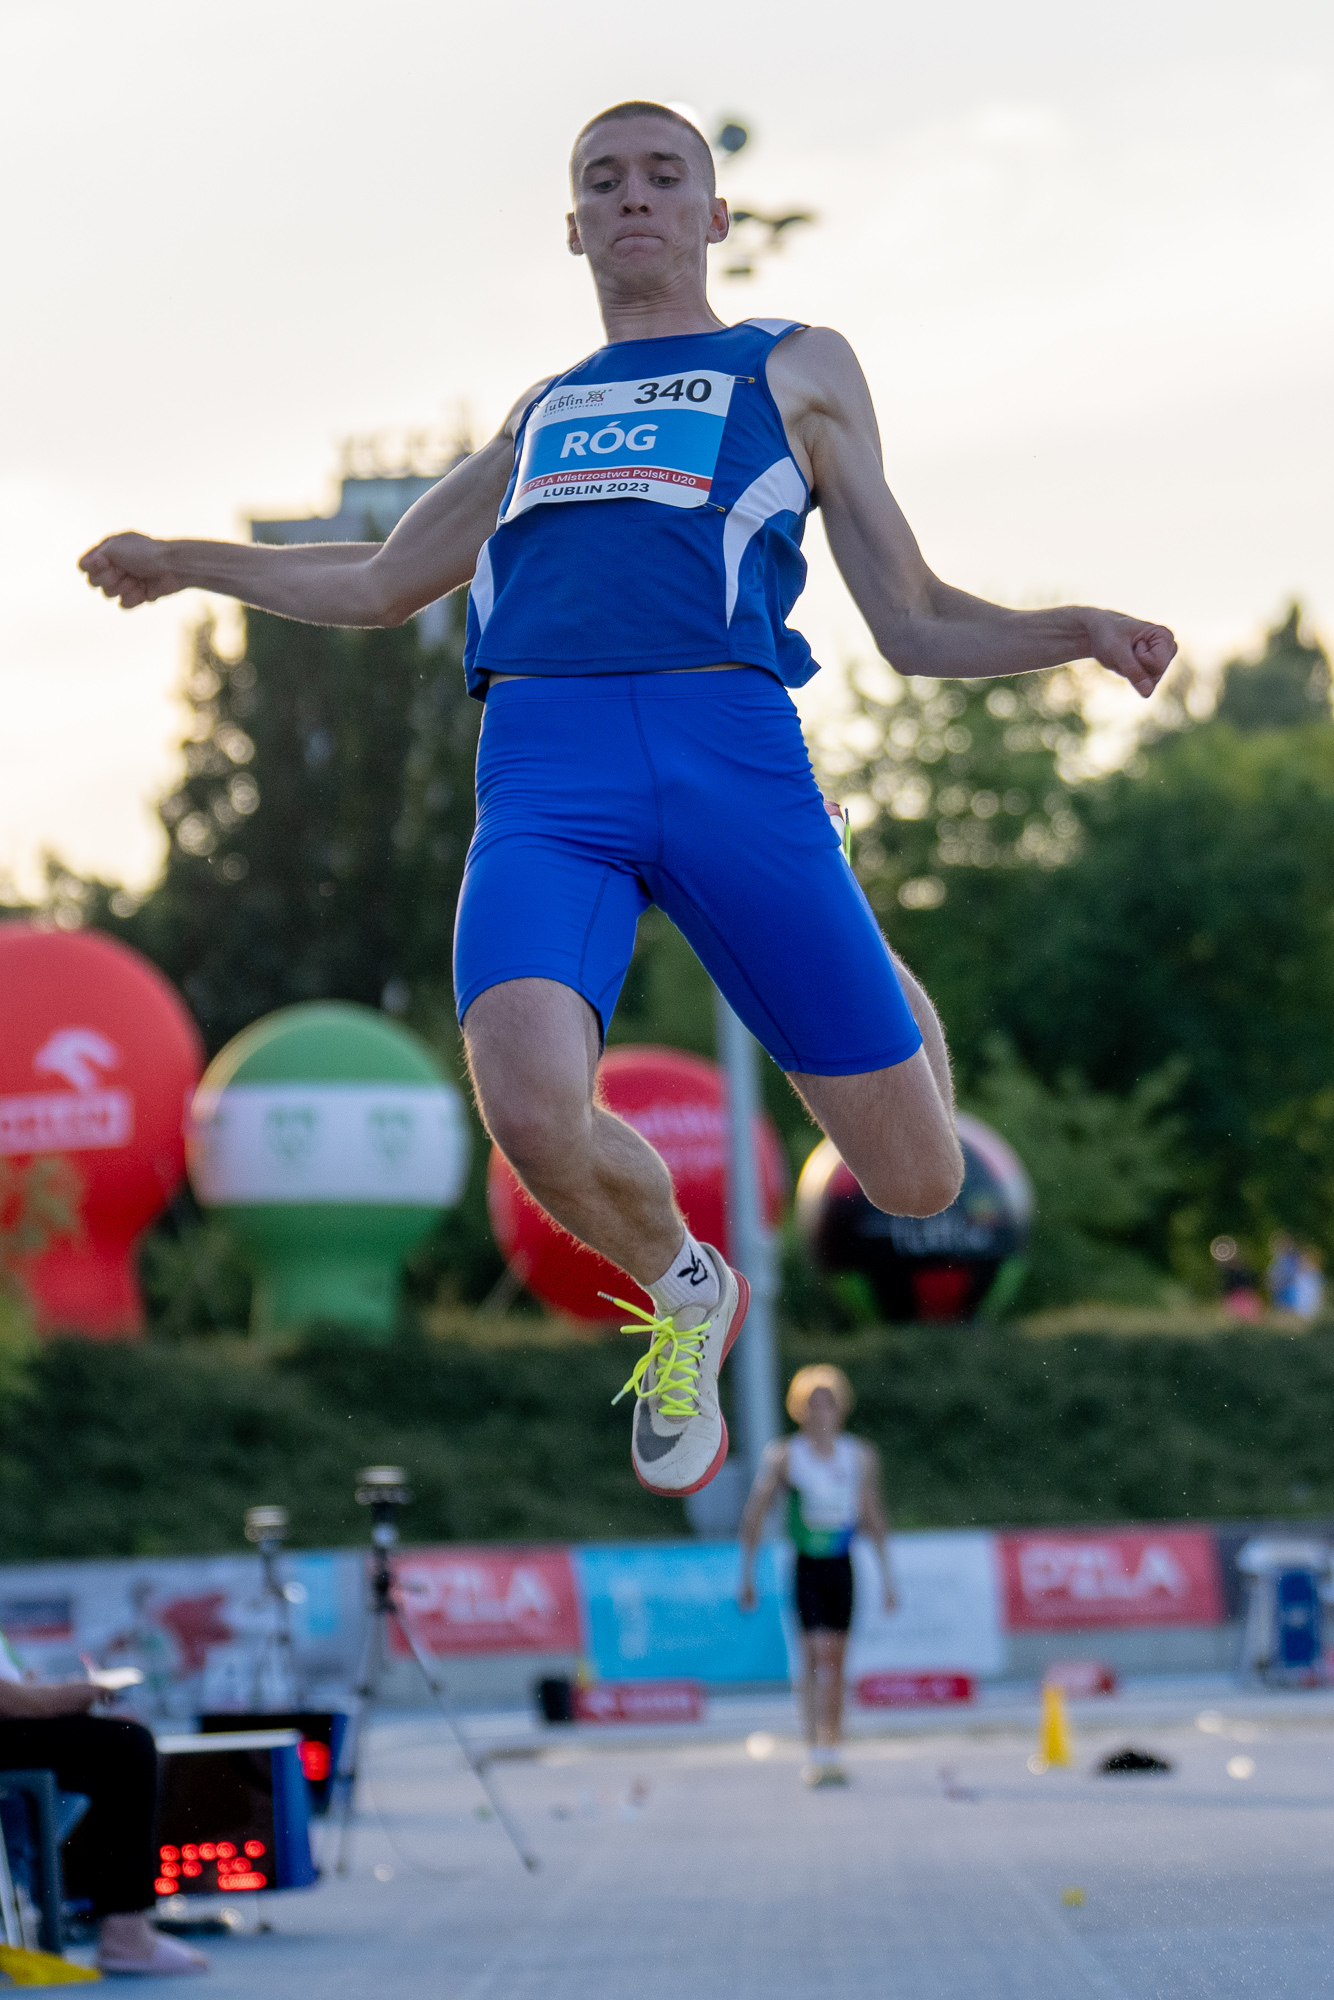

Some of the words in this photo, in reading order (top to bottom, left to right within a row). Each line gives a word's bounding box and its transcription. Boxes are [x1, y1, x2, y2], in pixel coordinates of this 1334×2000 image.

[634, 378, 712, 404] 340
[560, 421, 659, 459] RÓG
[528, 477, 553, 490] PZLA
[556, 470, 630, 483] Mistrzostwa
[632, 469, 669, 480] Polski
[672, 473, 696, 486] U20
[543, 484, 603, 497] LUBLIN
[606, 482, 650, 493] 2023
